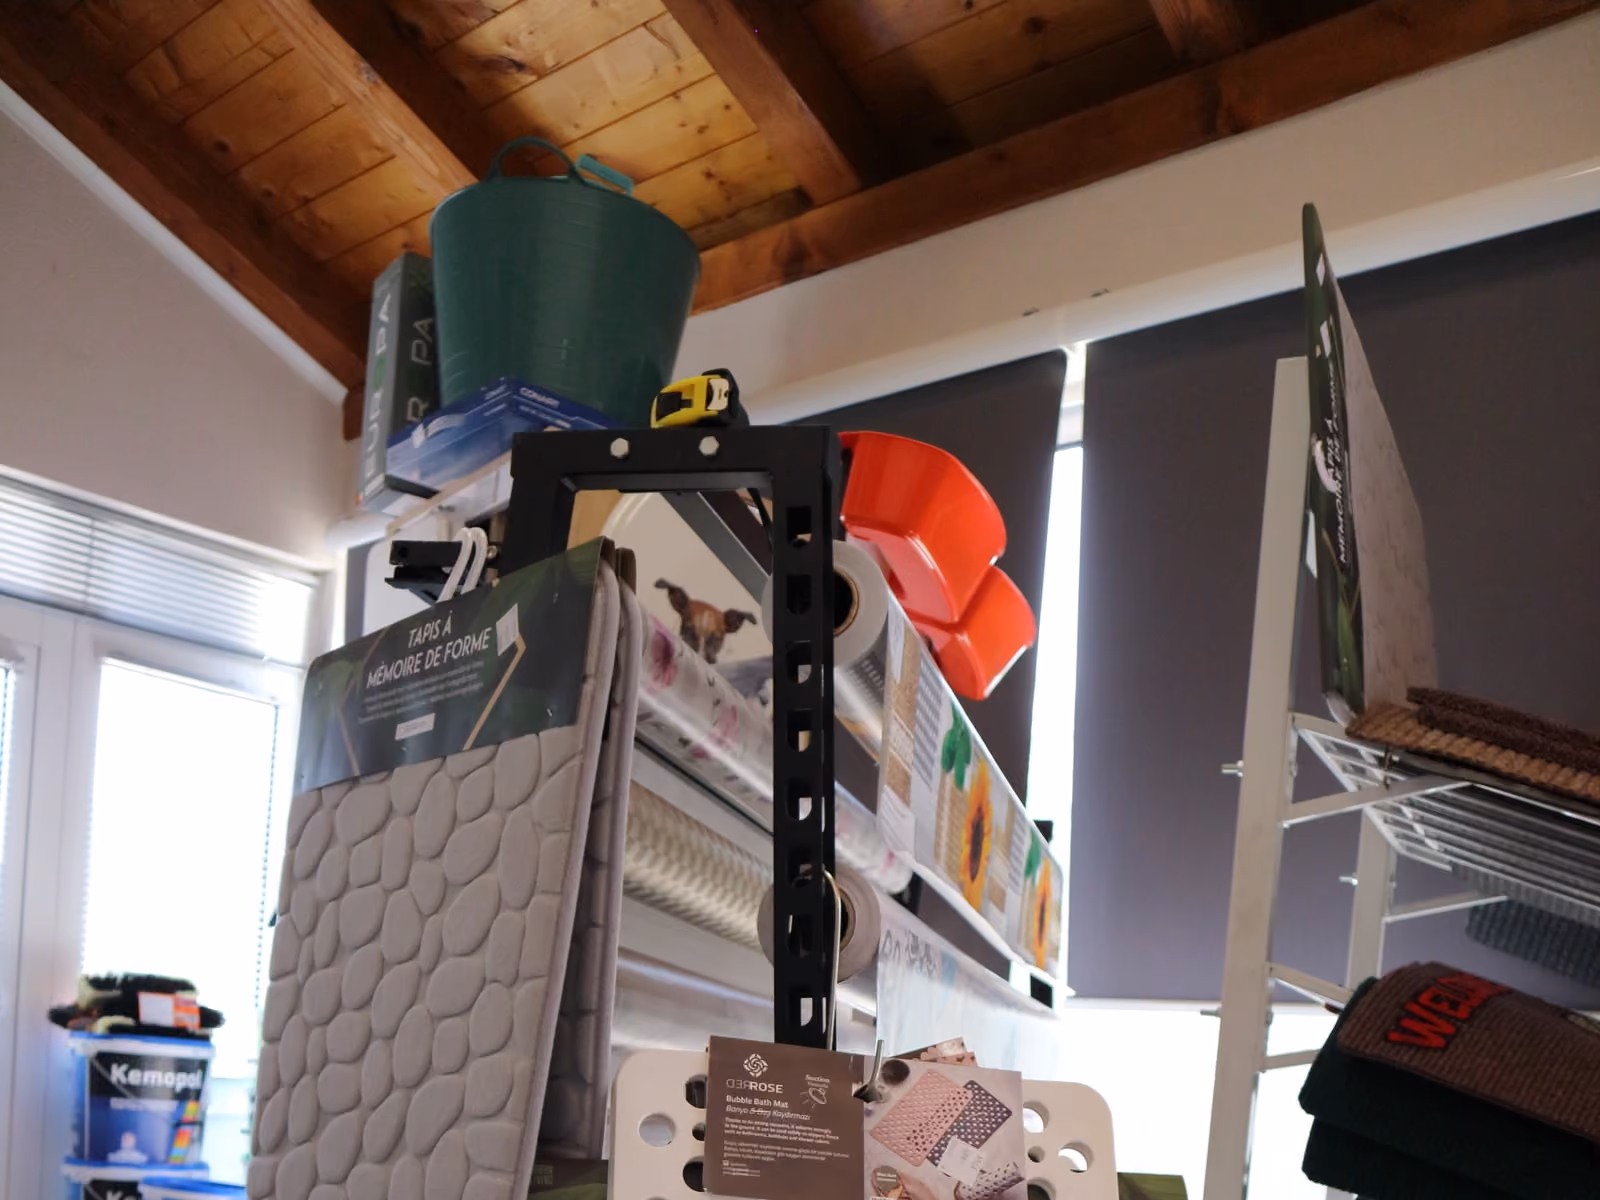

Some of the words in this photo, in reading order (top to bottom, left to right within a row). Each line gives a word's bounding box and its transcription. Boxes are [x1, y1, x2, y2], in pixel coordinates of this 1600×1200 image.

[407, 618, 441, 648] TAPIS
[366, 652, 421, 689] MÉMOIRE
[425, 648, 441, 668] DE
[444, 627, 492, 663] FORME
[110, 1062, 203, 1091] Kemopol
[726, 1095, 752, 1105] Bubble
[753, 1097, 772, 1107] Bath
[773, 1099, 789, 1108] Mat
[726, 1105, 748, 1114] Banyo
